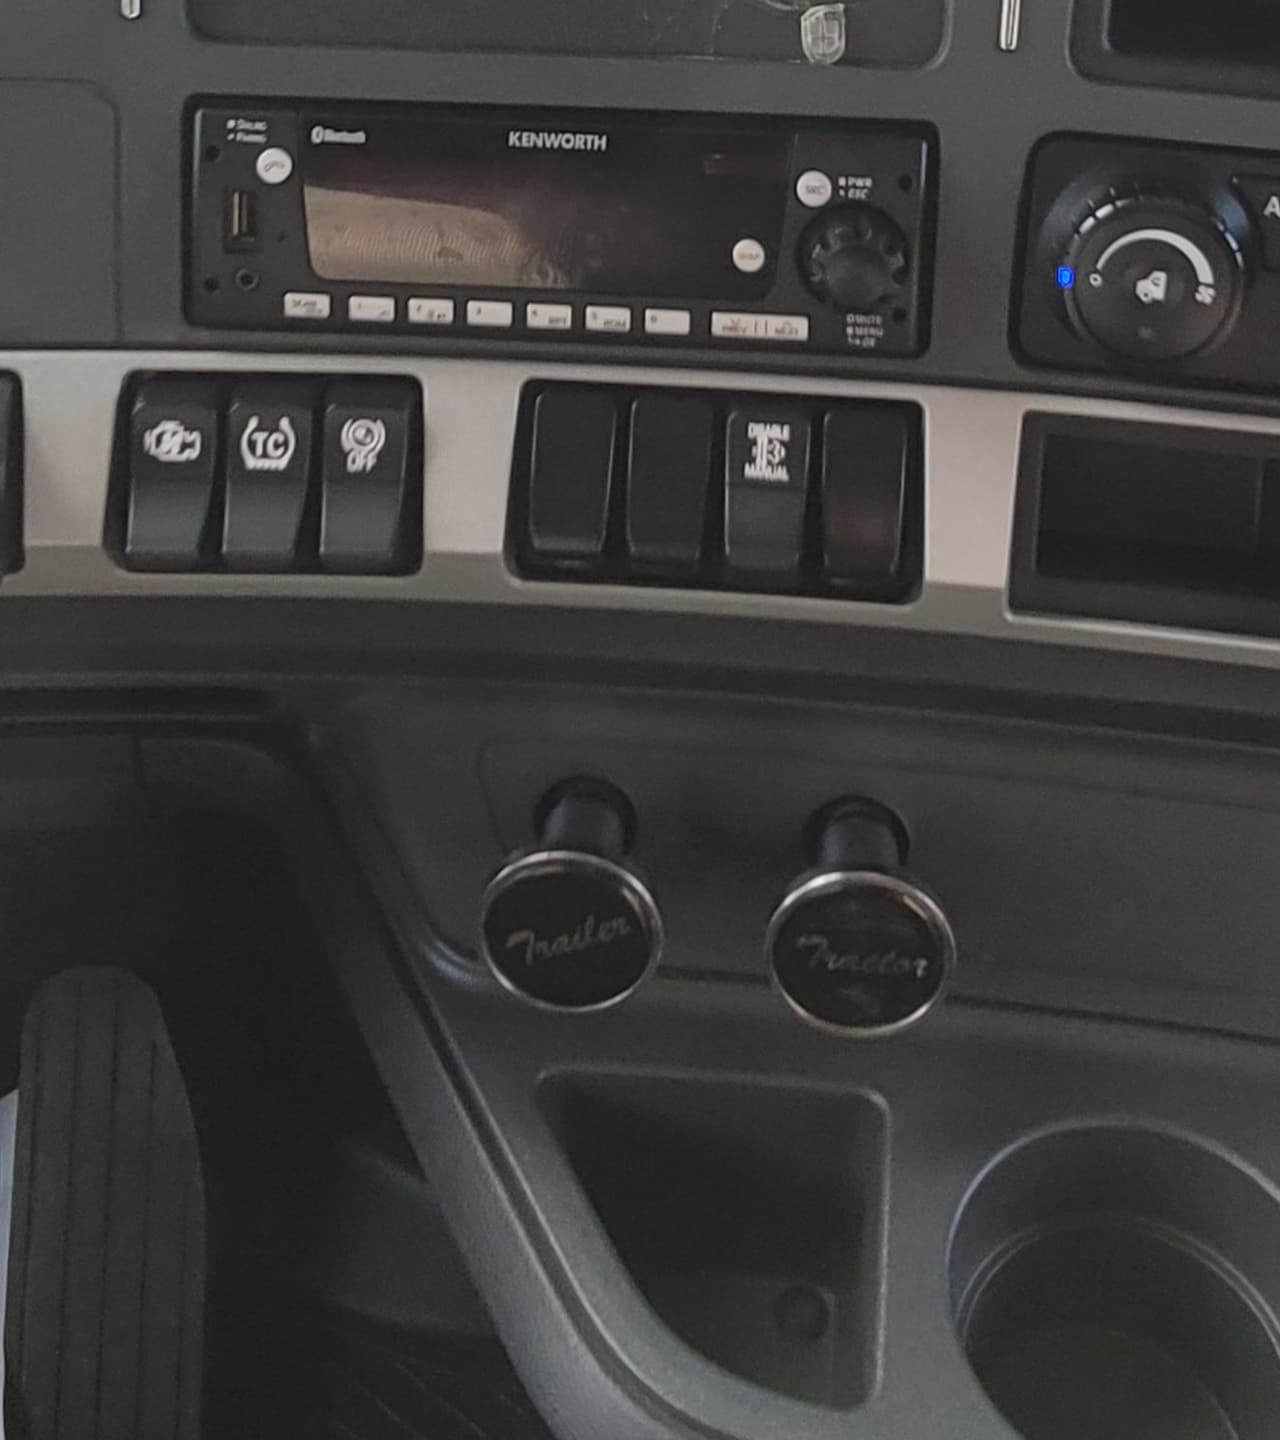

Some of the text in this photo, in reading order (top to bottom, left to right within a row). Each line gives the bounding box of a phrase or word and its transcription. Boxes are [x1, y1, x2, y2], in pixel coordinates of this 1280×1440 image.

[508, 130, 607, 151] KENWORTH
[848, 176, 872, 188] PWR
[848, 188, 868, 200] ESC
[251, 431, 286, 458] TC
[347, 451, 377, 472] OFF
[505, 914, 632, 966] Trailer
